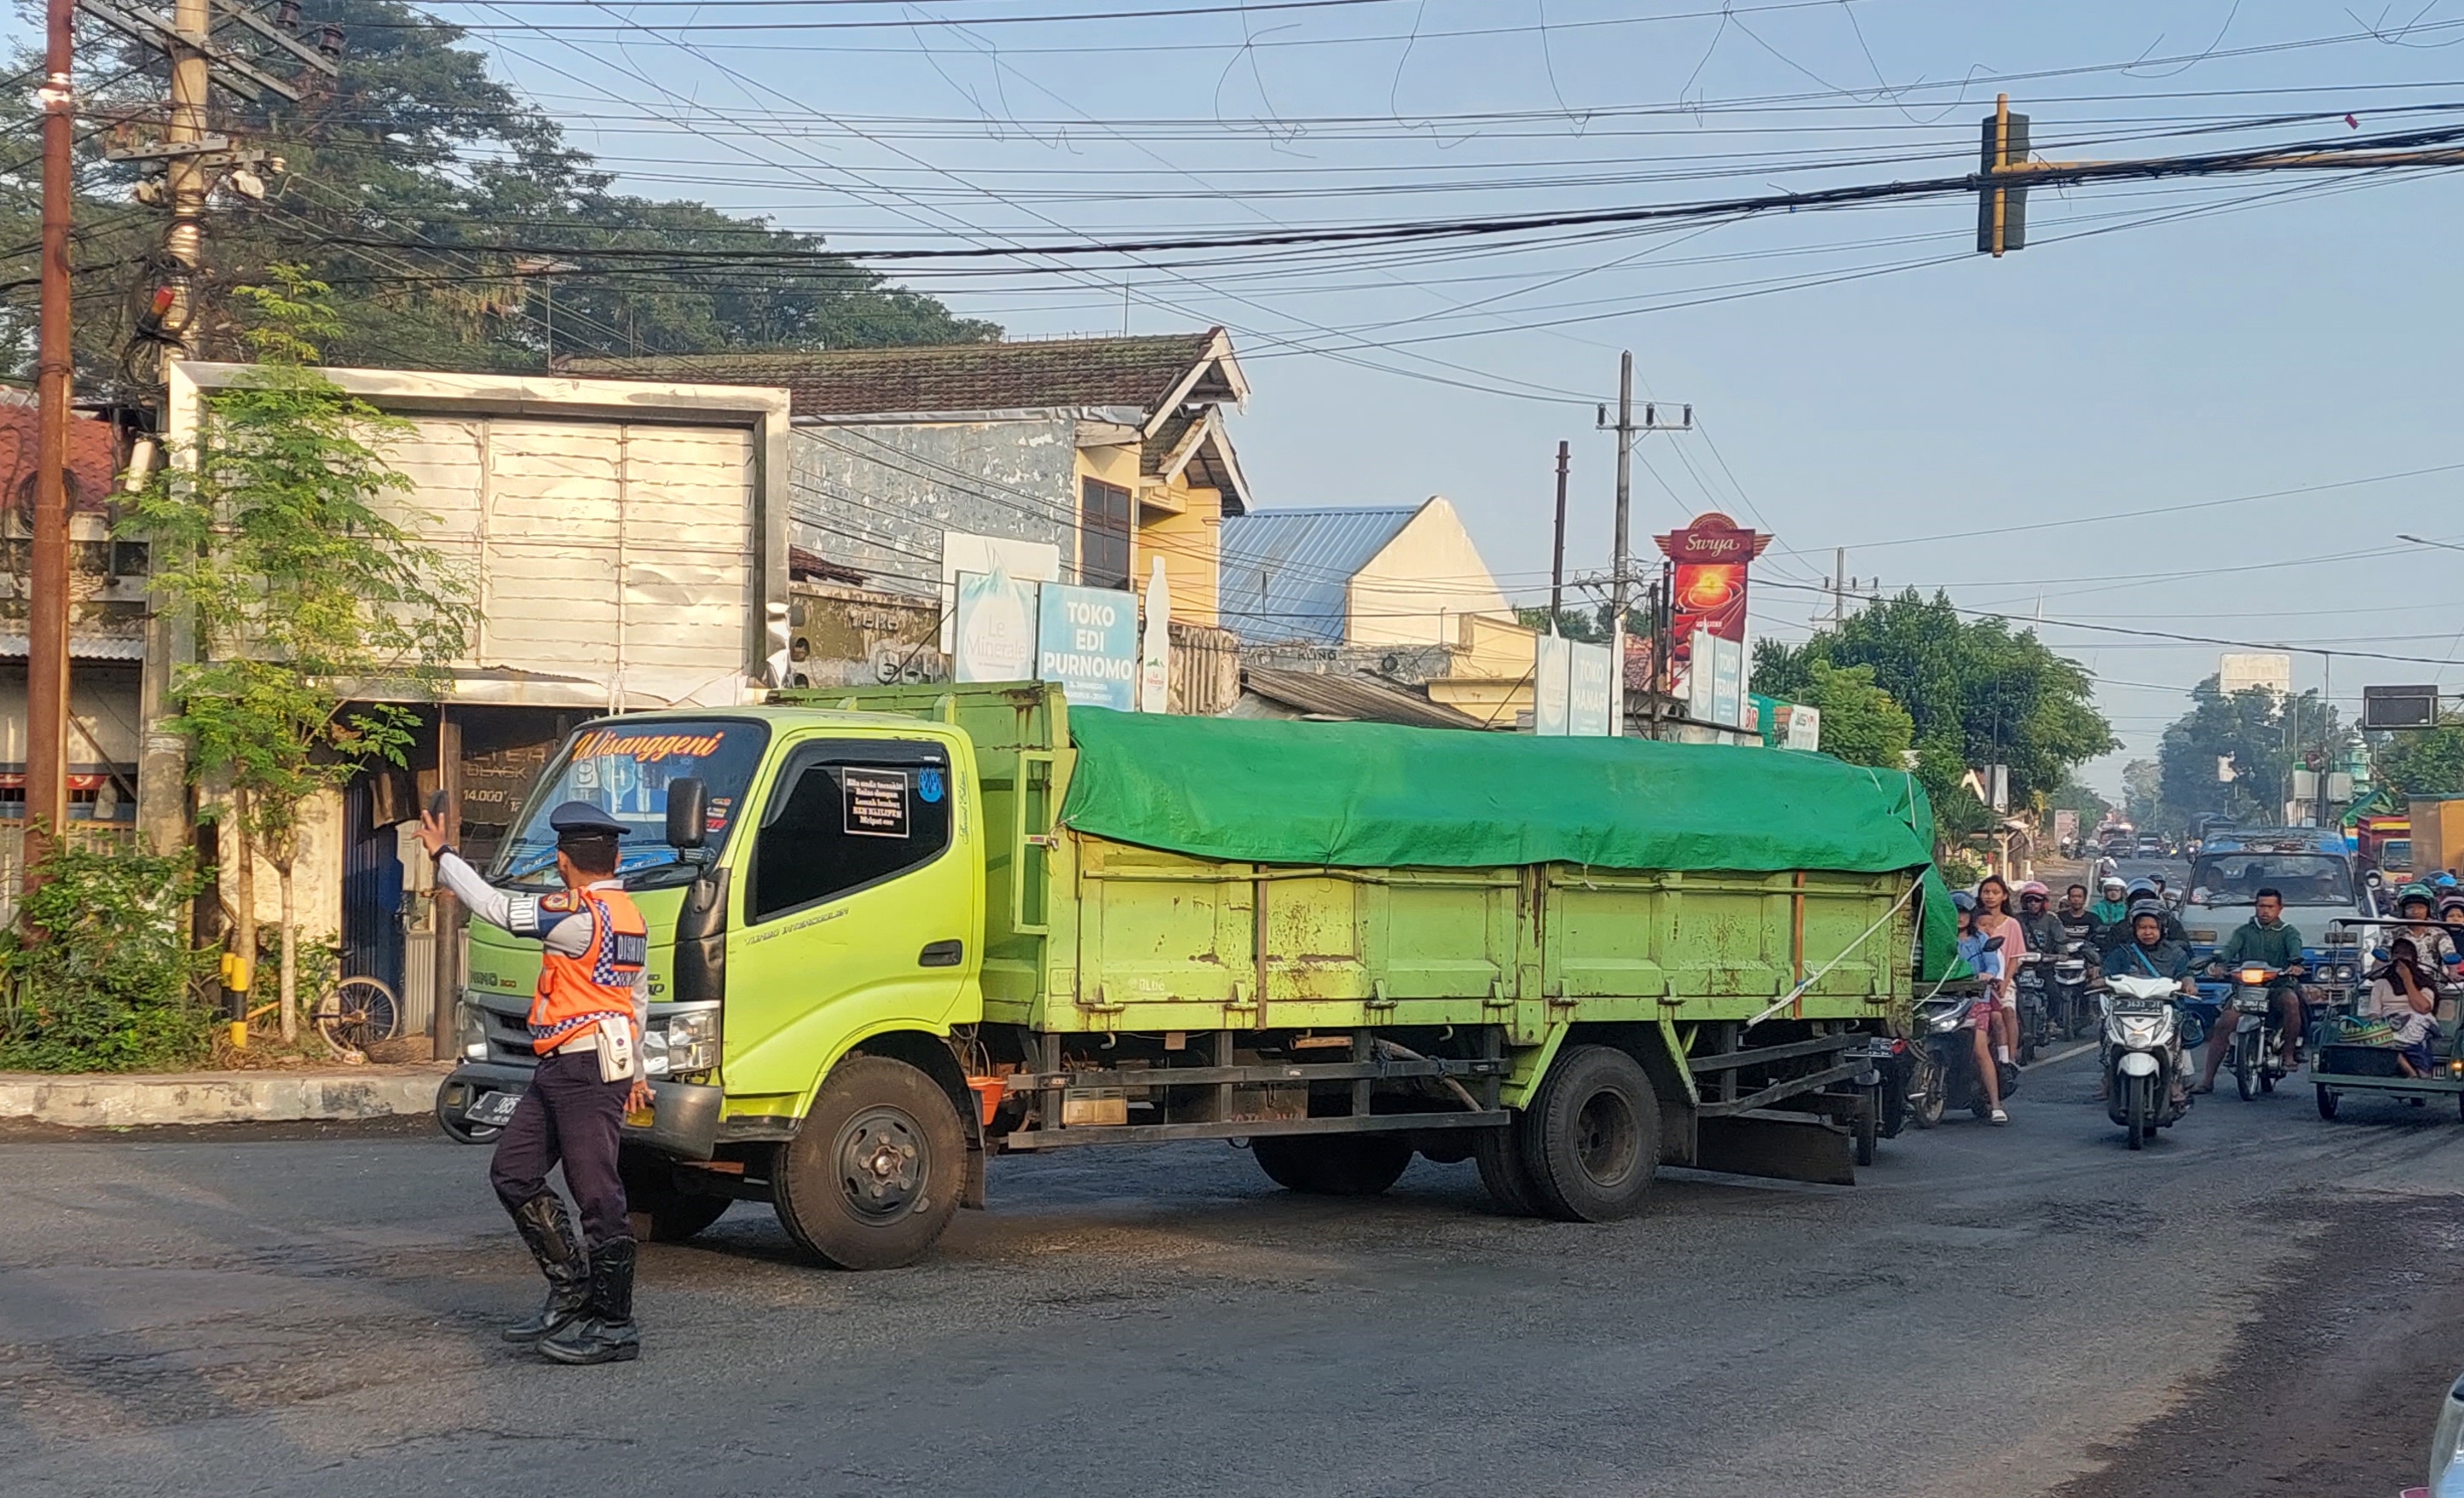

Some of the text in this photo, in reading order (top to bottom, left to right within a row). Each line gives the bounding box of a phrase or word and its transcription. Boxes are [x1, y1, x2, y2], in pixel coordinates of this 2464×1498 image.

[1685, 534, 1740, 556] Surya
[989, 614, 1005, 637] Le
[1067, 602, 1115, 627] TOKO
[965, 633, 1025, 661] Minerale
[1076, 629, 1104, 652] EDI
[1043, 652, 1133, 680] PURNOMO
[1579, 659, 1603, 683] TOKO
[1573, 689, 1607, 713] HANAFI
[572, 730, 725, 763] Wisanggeni
